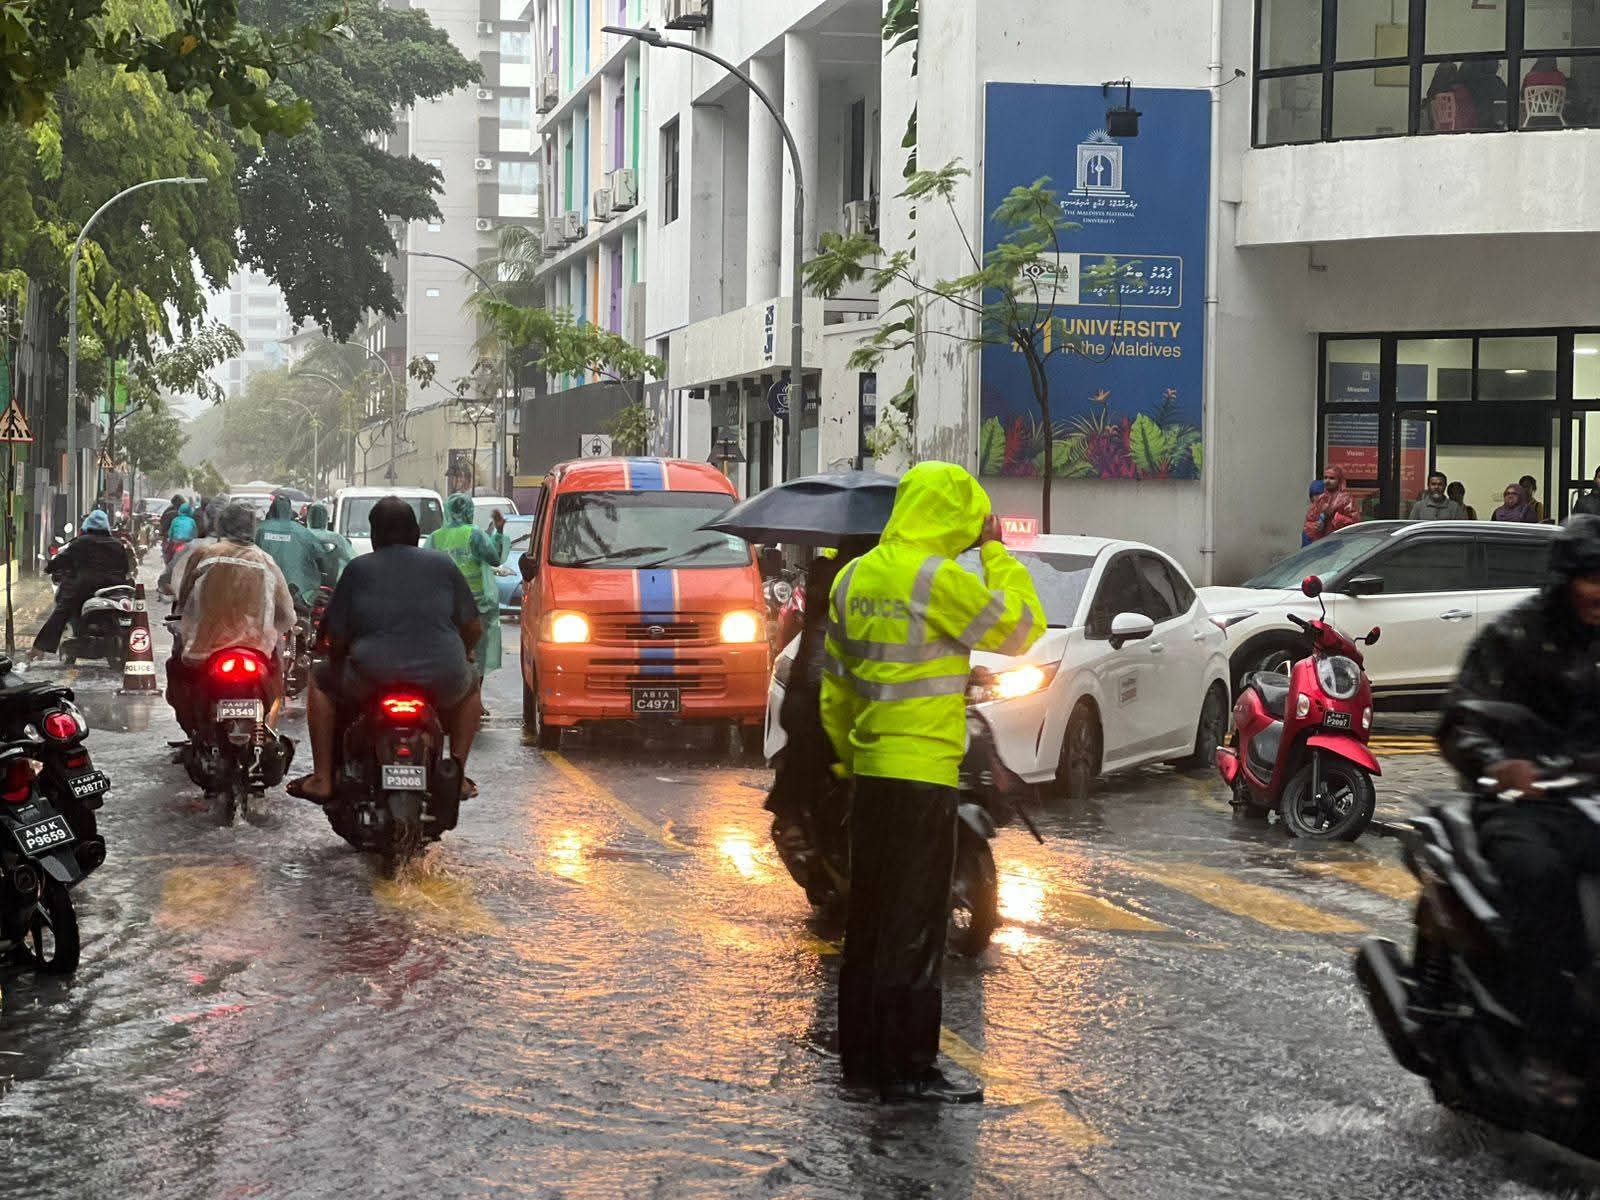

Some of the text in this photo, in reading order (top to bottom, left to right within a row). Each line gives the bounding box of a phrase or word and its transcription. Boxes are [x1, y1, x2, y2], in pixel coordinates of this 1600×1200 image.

[1063, 318, 1182, 338] UNIVERSITY
[1061, 341, 1182, 357] in the Maldives
[1004, 520, 1033, 534] TAXI
[850, 596, 908, 618] POLICE
[222, 708, 254, 716] P3549
[636, 699, 676, 709] C4971
[74, 779, 104, 796] P9877
[26, 829, 67, 849] P9659
